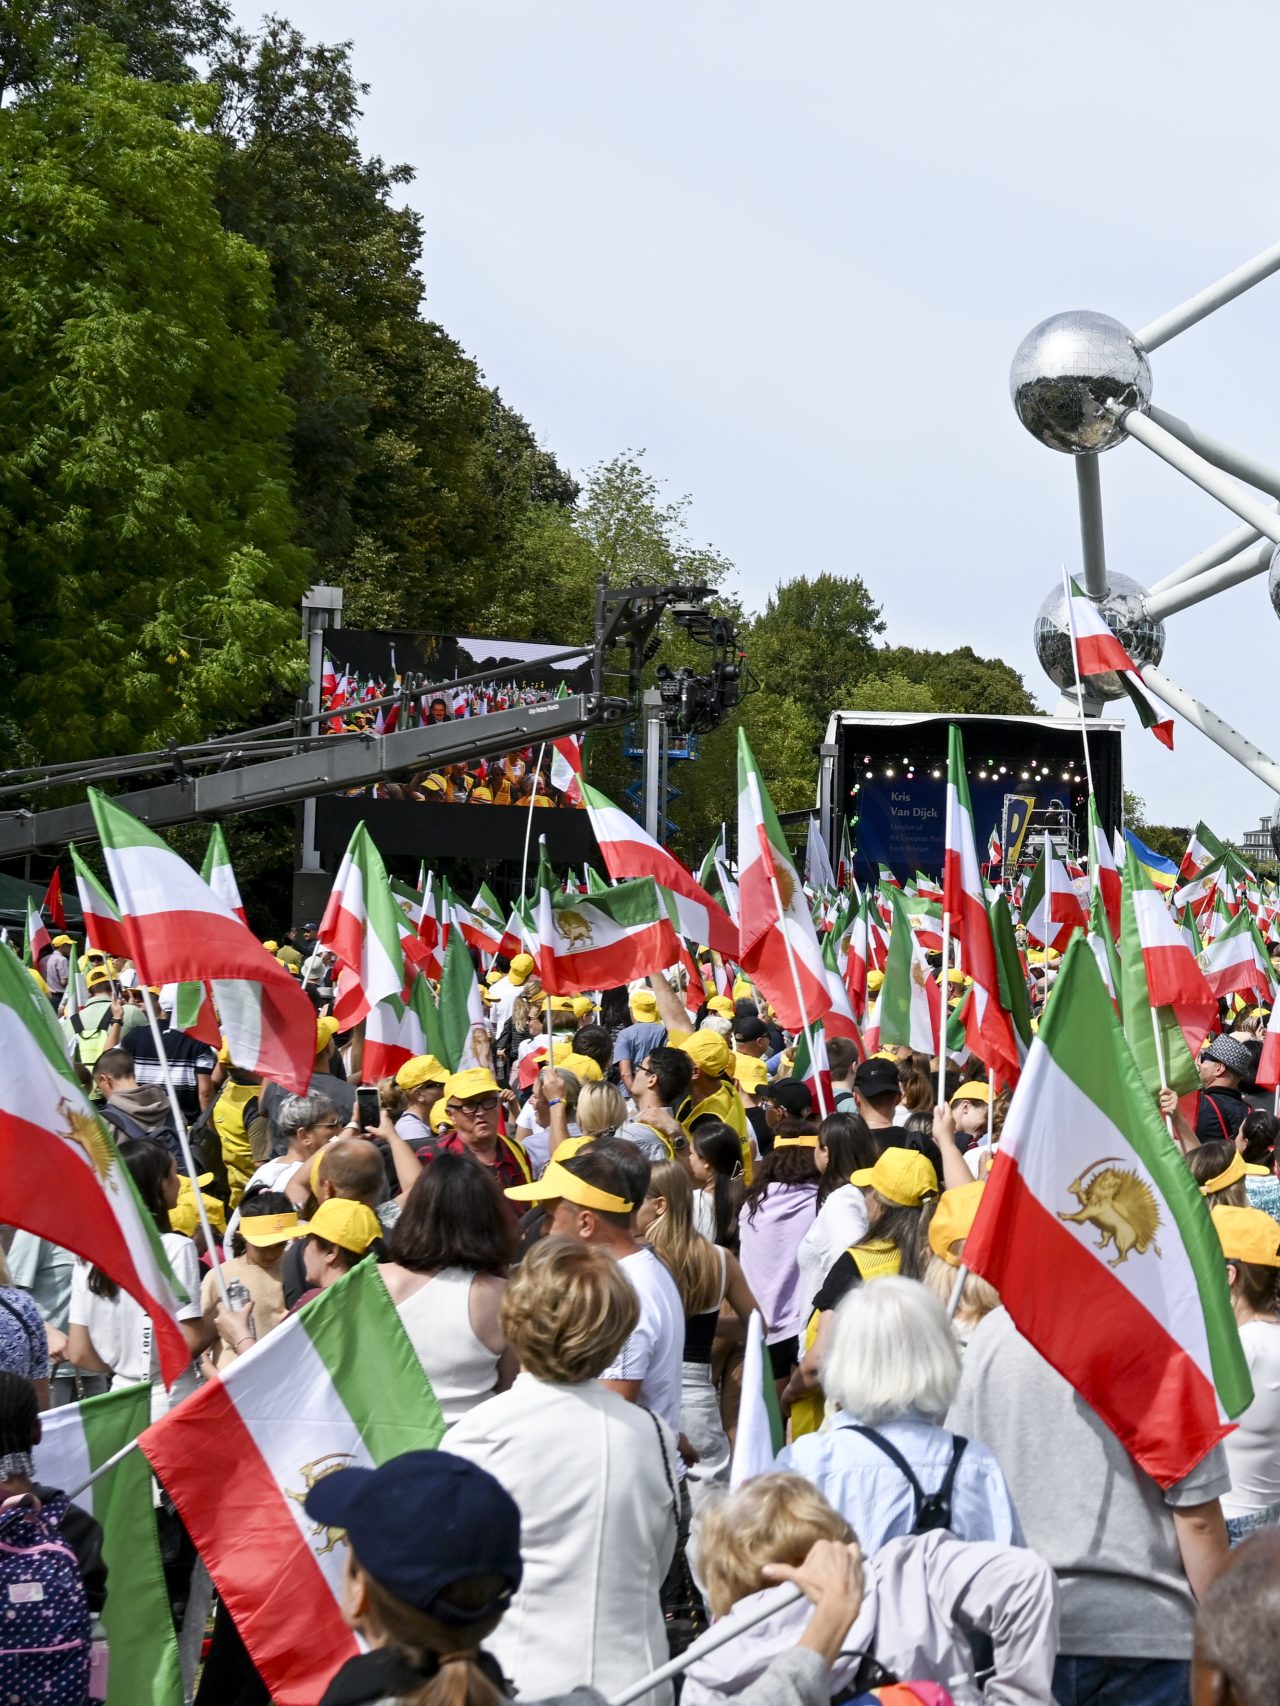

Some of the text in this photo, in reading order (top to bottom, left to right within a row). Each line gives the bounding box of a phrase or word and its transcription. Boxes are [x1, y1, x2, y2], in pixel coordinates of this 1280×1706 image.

[891, 791, 911, 802] Kris
[890, 806, 938, 820] Van Dijck
[900, 834, 929, 844] European
